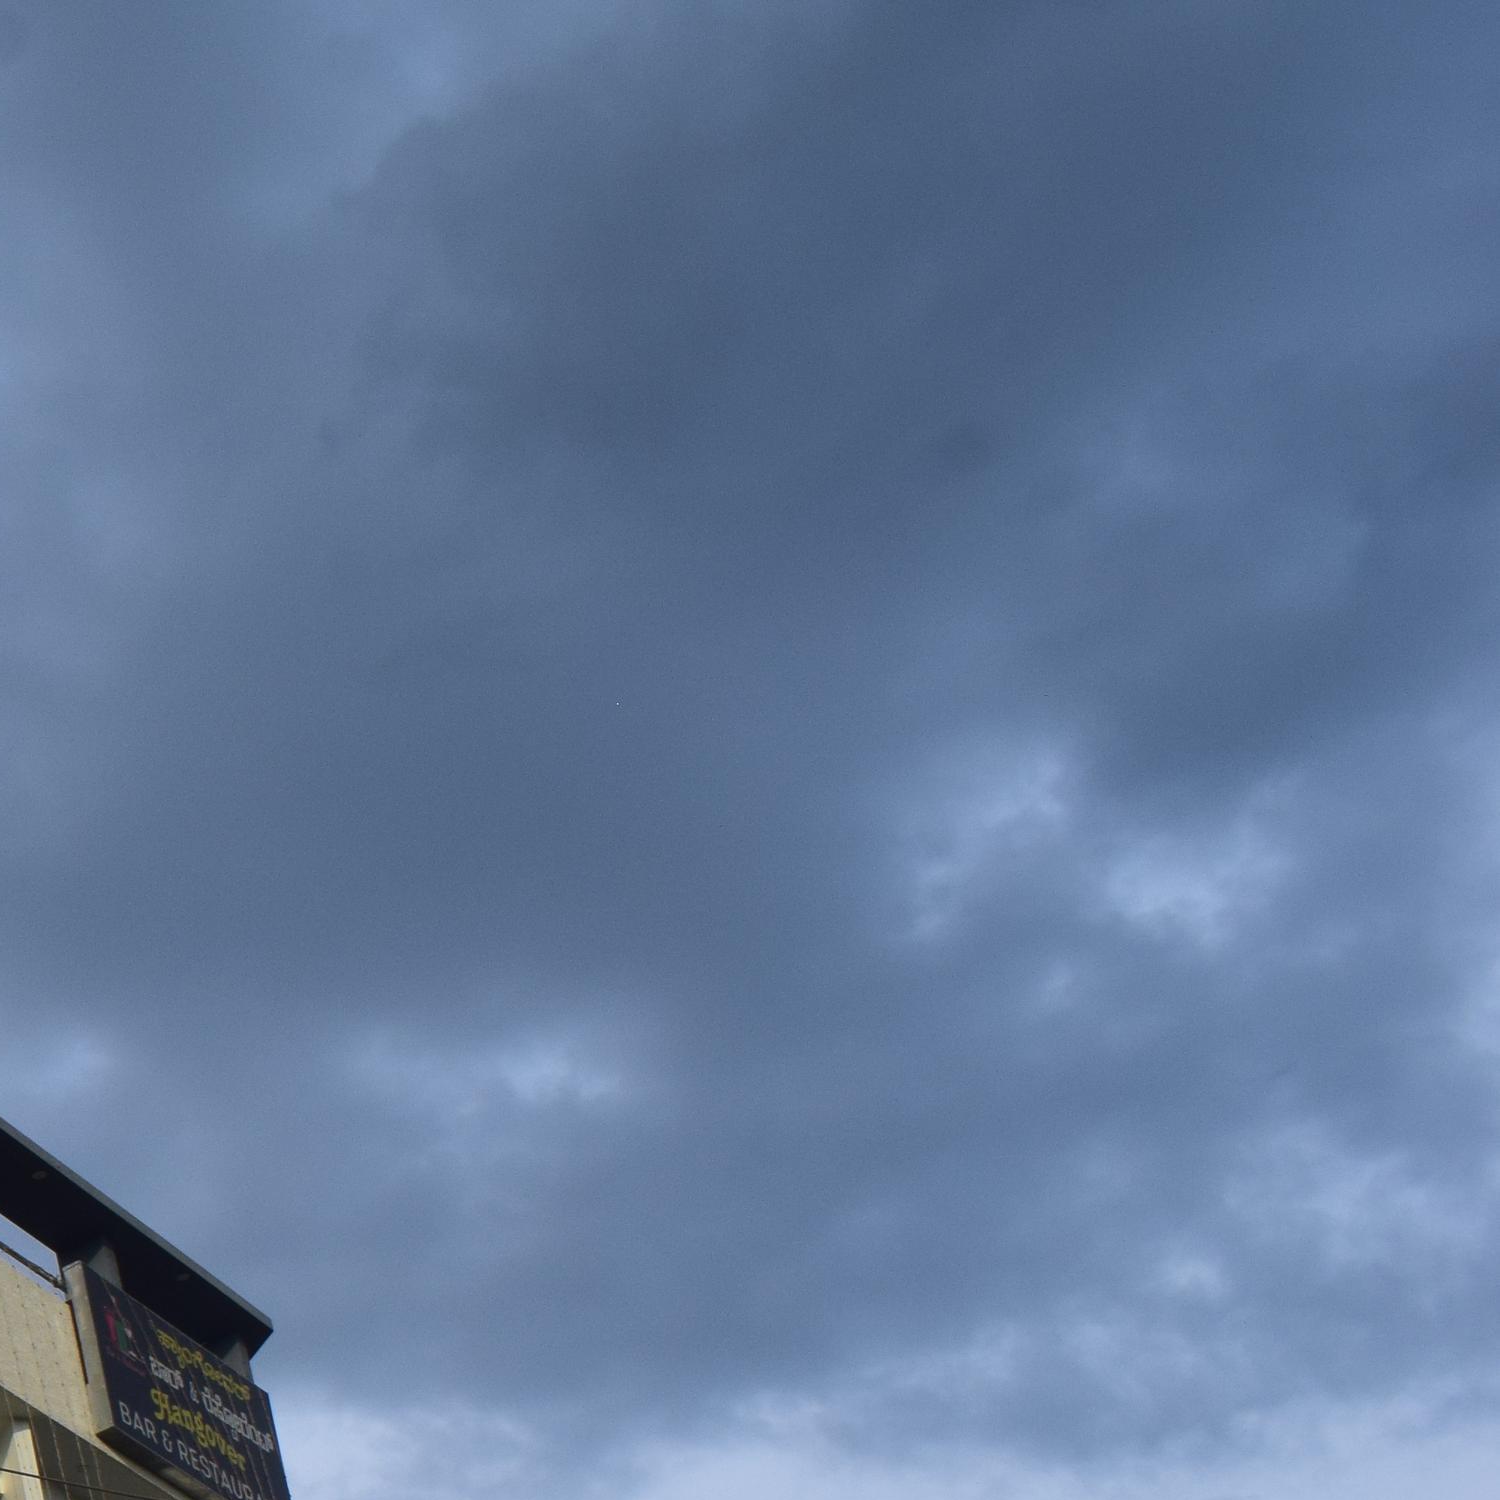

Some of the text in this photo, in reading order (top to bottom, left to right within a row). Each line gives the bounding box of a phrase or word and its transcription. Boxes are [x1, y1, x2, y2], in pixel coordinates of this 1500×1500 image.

[118, 1399, 157, 1445] BAR
[162, 1429, 174, 1453] &
[151, 1386, 246, 1472] Hangover
